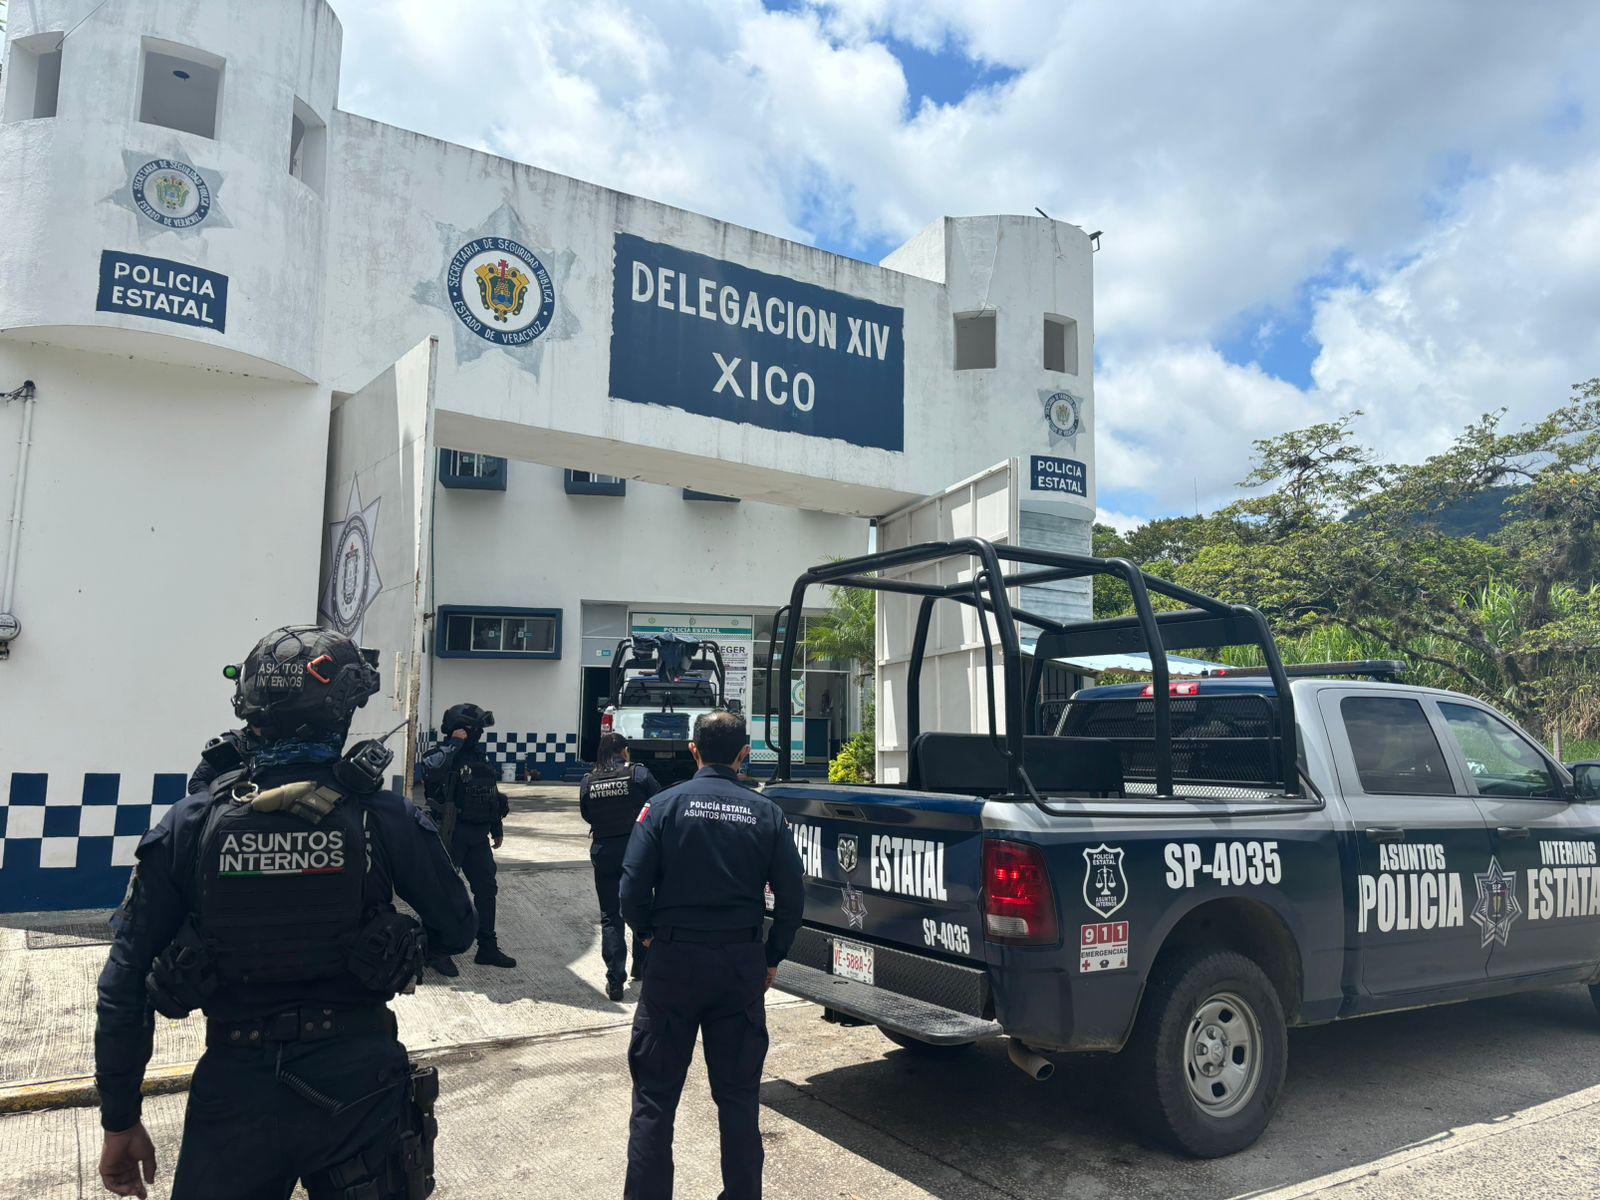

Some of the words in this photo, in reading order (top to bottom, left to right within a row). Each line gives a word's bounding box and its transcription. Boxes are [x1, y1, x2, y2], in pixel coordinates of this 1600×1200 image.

[114, 262, 215, 298] POLICIA
[449, 242, 480, 287] SECRETARIA
[483, 238, 495, 249] DE
[498, 239, 539, 268] SEGURIDAD
[537, 269, 552, 303] PUBLICA
[112, 285, 214, 323] ESTATAL
[632, 260, 836, 350] DELEGACION
[847, 316, 890, 361] XIV
[453, 301, 481, 331] ESTADO
[484, 330, 496, 341] DE
[501, 321, 544, 343] VERACRUZ
[712, 352, 815, 412] XICO
[1037, 460, 1082, 477] POLICIA
[1038, 476, 1082, 493] ESTATAL
[590, 781, 629, 791] ASUNTOS
[590, 788, 629, 799] INTERNOS
[683, 809, 719, 820] ASUNTOS
[720, 812, 757, 825] INTERNOS
[690, 801, 720, 811] POLICÍA
[721, 803, 752, 815] ESTATAL
[220, 830, 344, 853] ASUNTOS
[1379, 843, 1446, 871] ASUNTOS
[1539, 840, 1597, 865] INTERNOS
[219, 850, 345, 872] INTERNOS
[870, 834, 948, 902] ESTATAL
[1164, 841, 1282, 889] SP-4035
[1358, 872, 1464, 933] POLICIA
[1527, 866, 1600, 920] ESTATA
[922, 917, 971, 955] SP-4035
[1085, 926, 1123, 943] 911
[1081, 948, 1128, 958] EMERGENCIAS
